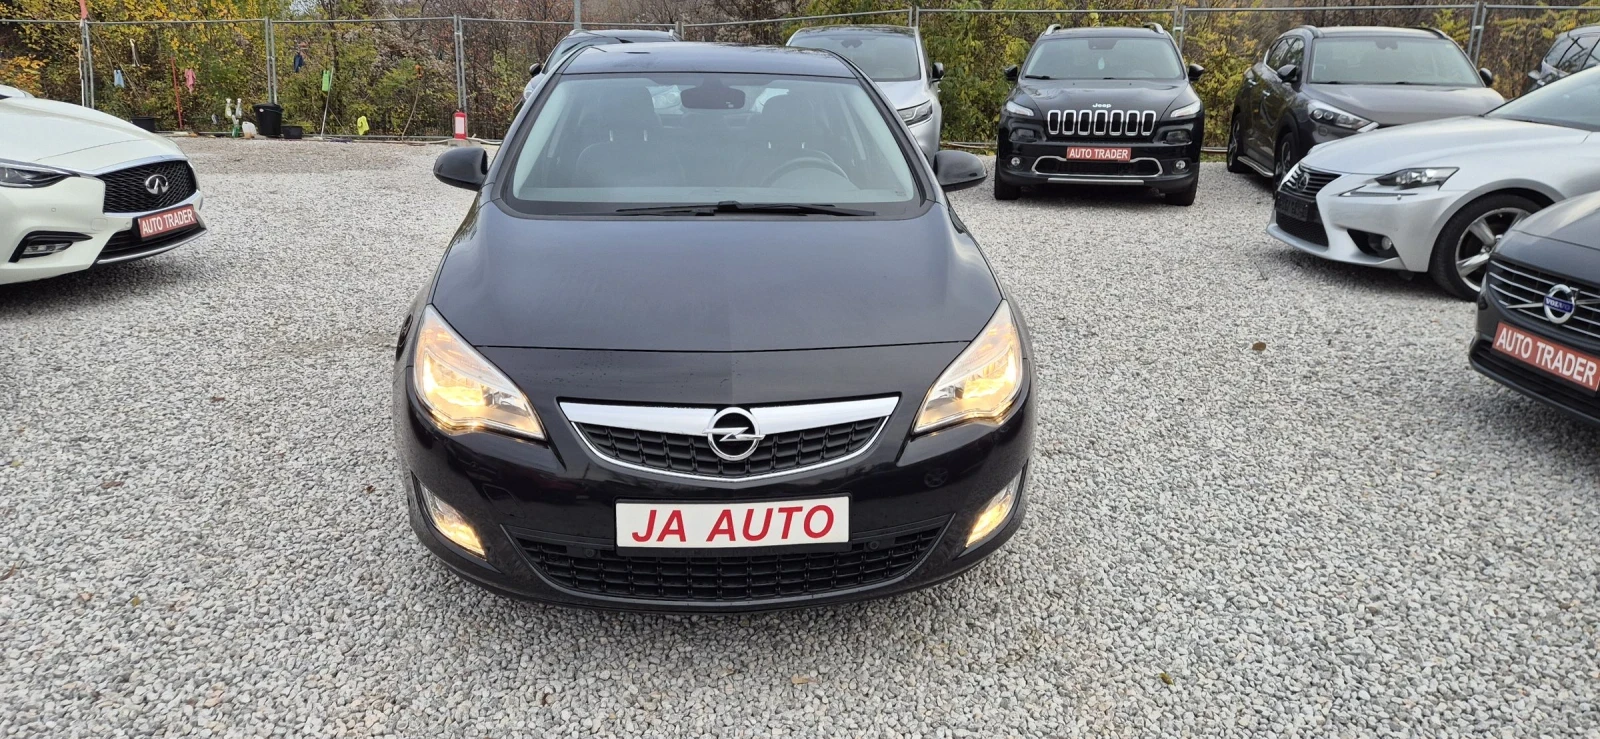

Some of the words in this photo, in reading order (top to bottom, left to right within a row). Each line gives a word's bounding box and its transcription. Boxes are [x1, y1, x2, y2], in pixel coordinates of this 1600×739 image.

[1070, 149, 1091, 158] AUTO
[1094, 149, 1128, 159] TRADER
[142, 217, 163, 234] AUTO
[163, 209, 194, 228] TRADER
[1545, 298, 1571, 311] VOLVO
[1496, 327, 1532, 358] AUTO
[1535, 342, 1597, 386] TRADER
[632, 509, 686, 543] JA
[706, 505, 835, 542] AUTO
